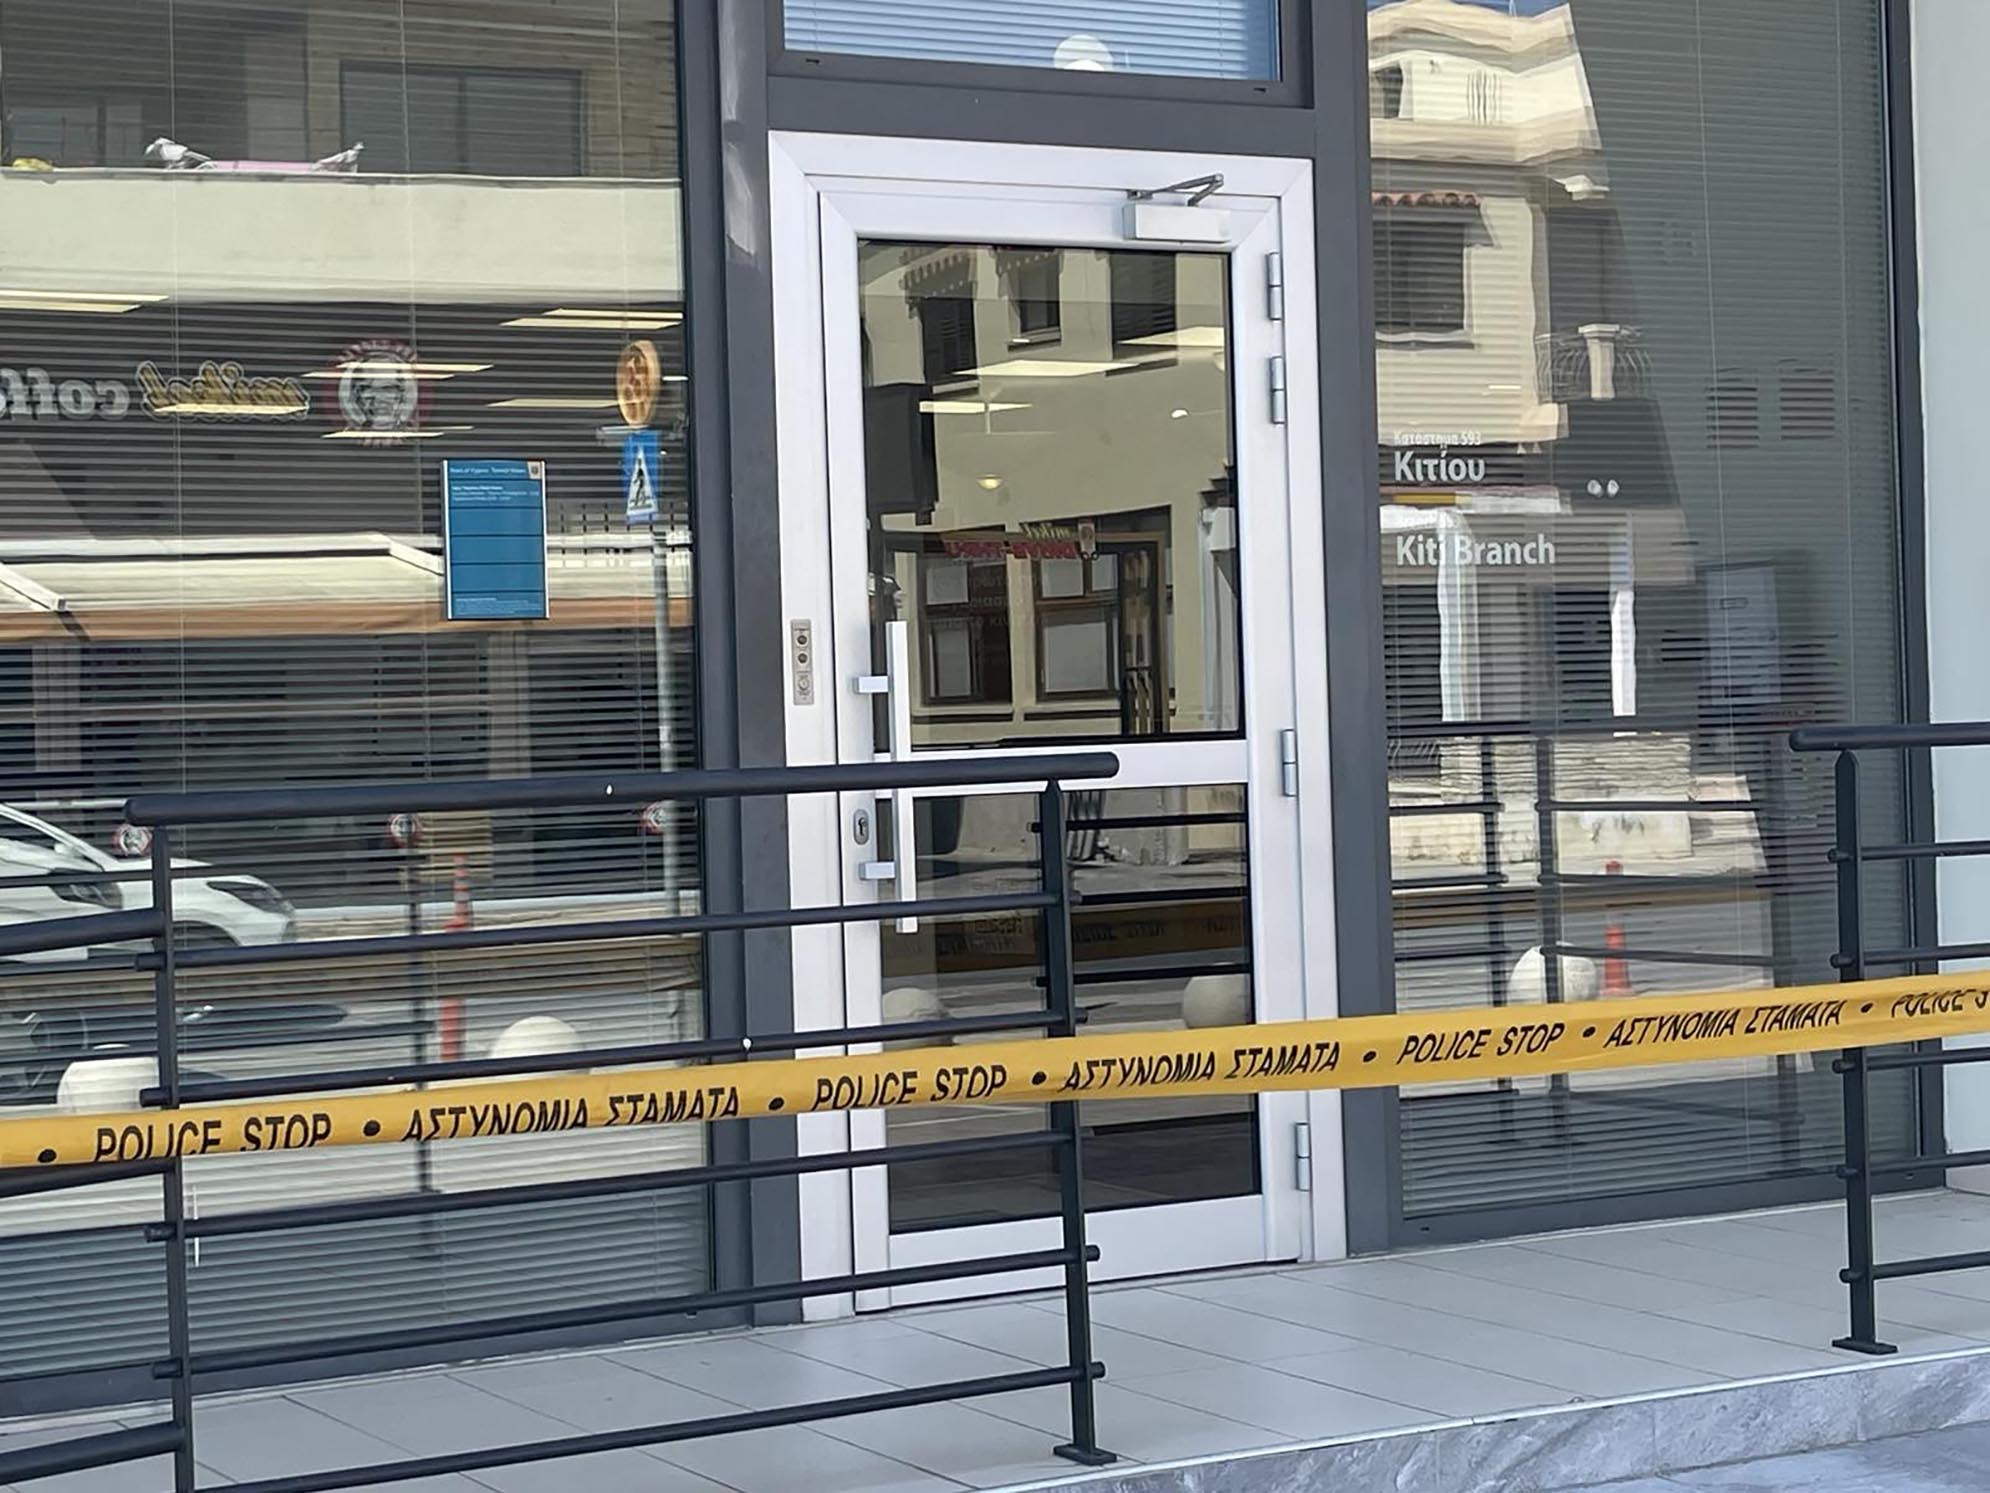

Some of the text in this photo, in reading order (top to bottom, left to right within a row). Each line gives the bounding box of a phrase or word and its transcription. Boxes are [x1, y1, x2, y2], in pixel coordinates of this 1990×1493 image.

[1461, 431, 1481, 445] 593
[1394, 450, 1486, 482] Κιτίου
[1396, 533, 1556, 566] Kiti Branch
[1395, 1022, 1566, 1065] POLICE STOP
[1602, 999, 1848, 1049] ΑΣΤΥΝΟΜΙΑ ΣΤΑΜΑΤΑ
[1056, 1041, 1340, 1093] ΑΣΤΥΝΟΜΙΑ ΣΤΑΜΑΤΑ
[810, 1064, 1007, 1112] POLICE STOP
[238, 1112, 332, 1152] STOP
